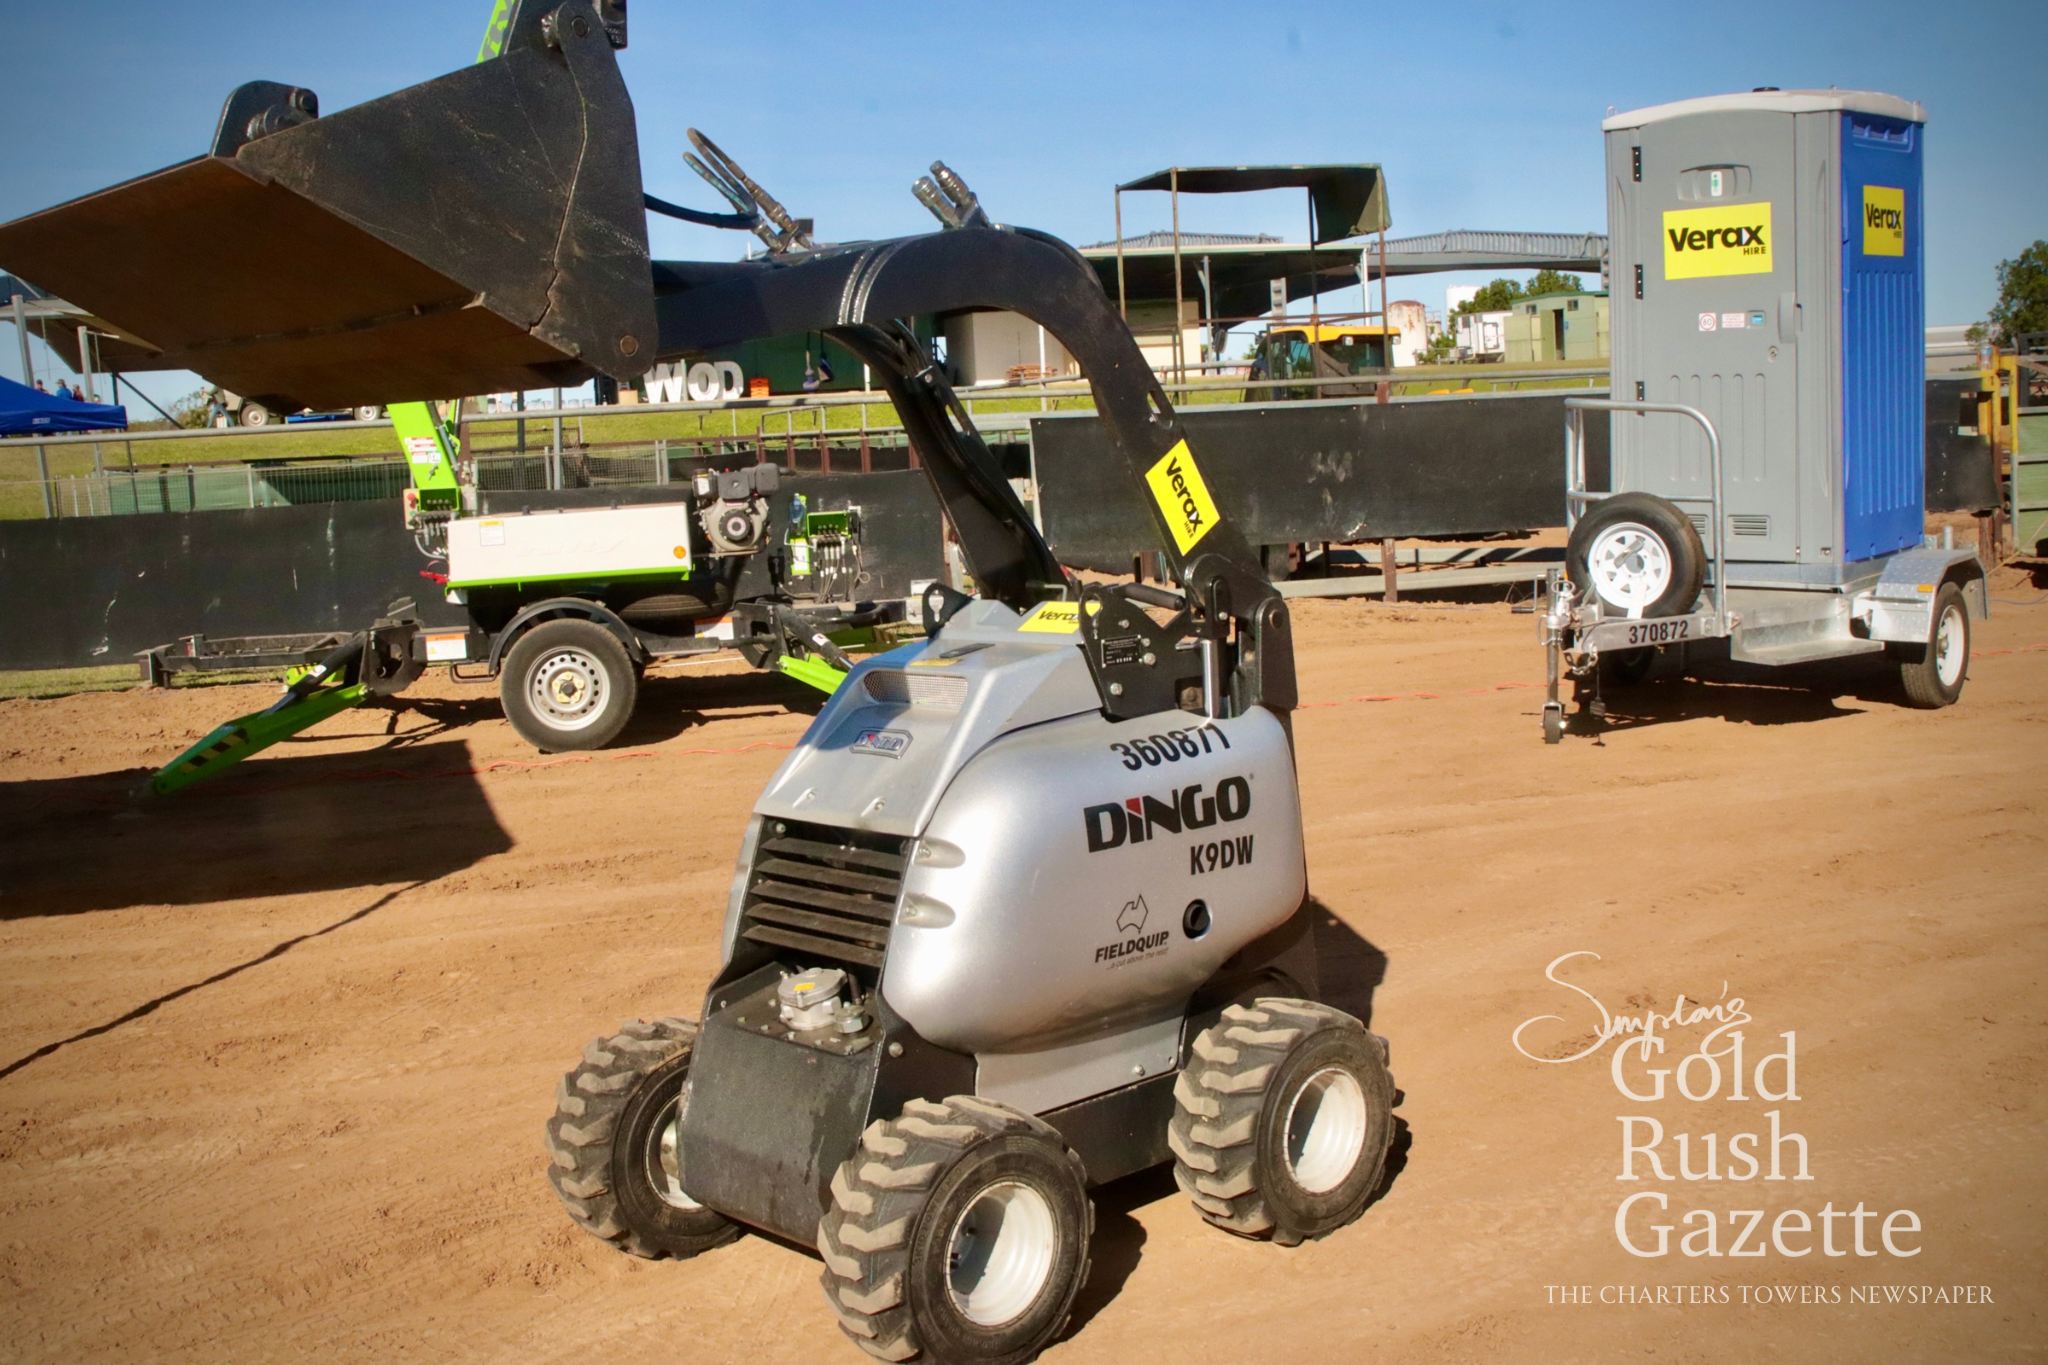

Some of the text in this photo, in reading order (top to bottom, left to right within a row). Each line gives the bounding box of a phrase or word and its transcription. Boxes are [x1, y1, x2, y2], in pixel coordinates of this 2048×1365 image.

[1865, 203, 1902, 230] Verax
[1668, 225, 1765, 252] Verax
[1743, 246, 1766, 256] HIRE
[643, 360, 744, 404] WOD
[1166, 456, 1204, 534] Verax
[1183, 521, 1194, 539] HIRE
[1628, 620, 1689, 644] 370872
[1110, 723, 1231, 771] 360871
[1190, 834, 1254, 876] K9DW
